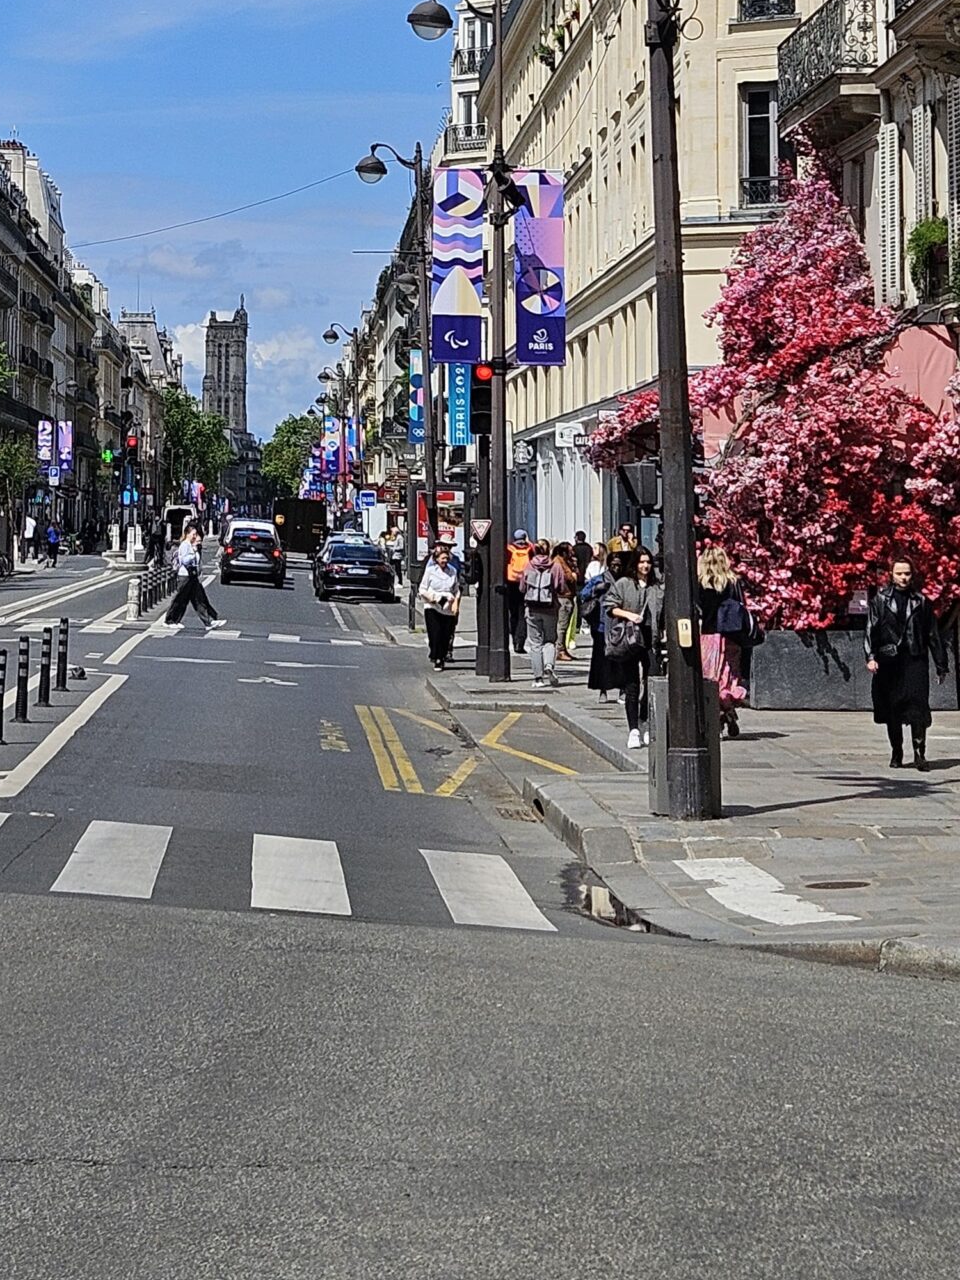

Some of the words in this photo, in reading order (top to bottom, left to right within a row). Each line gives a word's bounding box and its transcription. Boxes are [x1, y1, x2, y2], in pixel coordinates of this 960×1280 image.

[528, 342, 554, 351] PARIS
[455, 363, 465, 394] 202
[455, 398, 465, 438] PARIS
